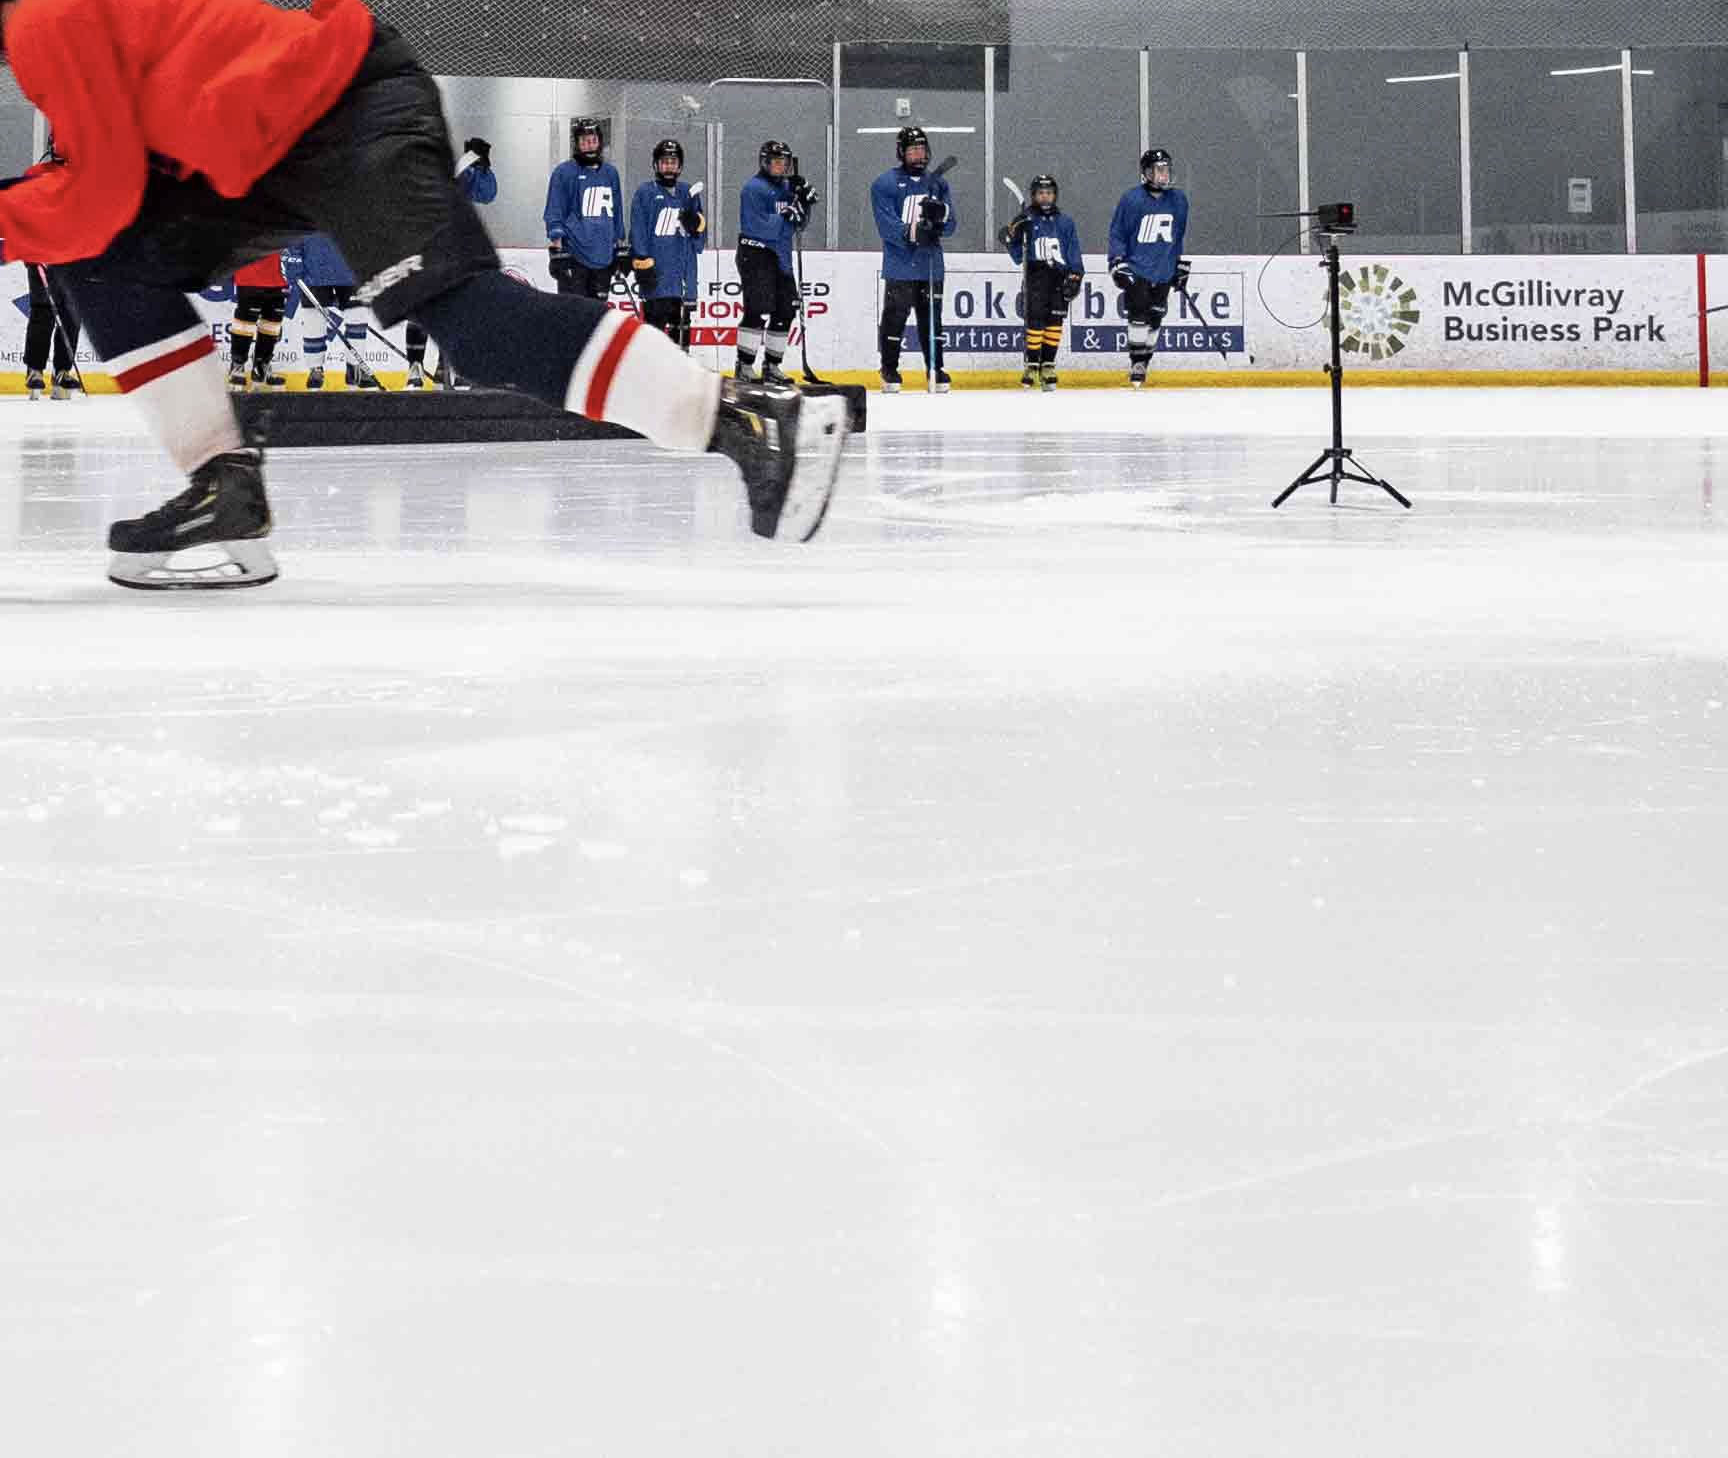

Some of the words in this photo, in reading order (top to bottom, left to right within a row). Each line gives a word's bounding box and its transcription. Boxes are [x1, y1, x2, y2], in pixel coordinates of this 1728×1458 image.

[1443, 279, 1624, 314] McGillivray
[1083, 328, 1101, 350] &
[1116, 328, 1232, 351] ptners
[1444, 315, 1581, 342] Business
[1593, 314, 1666, 342] Park
